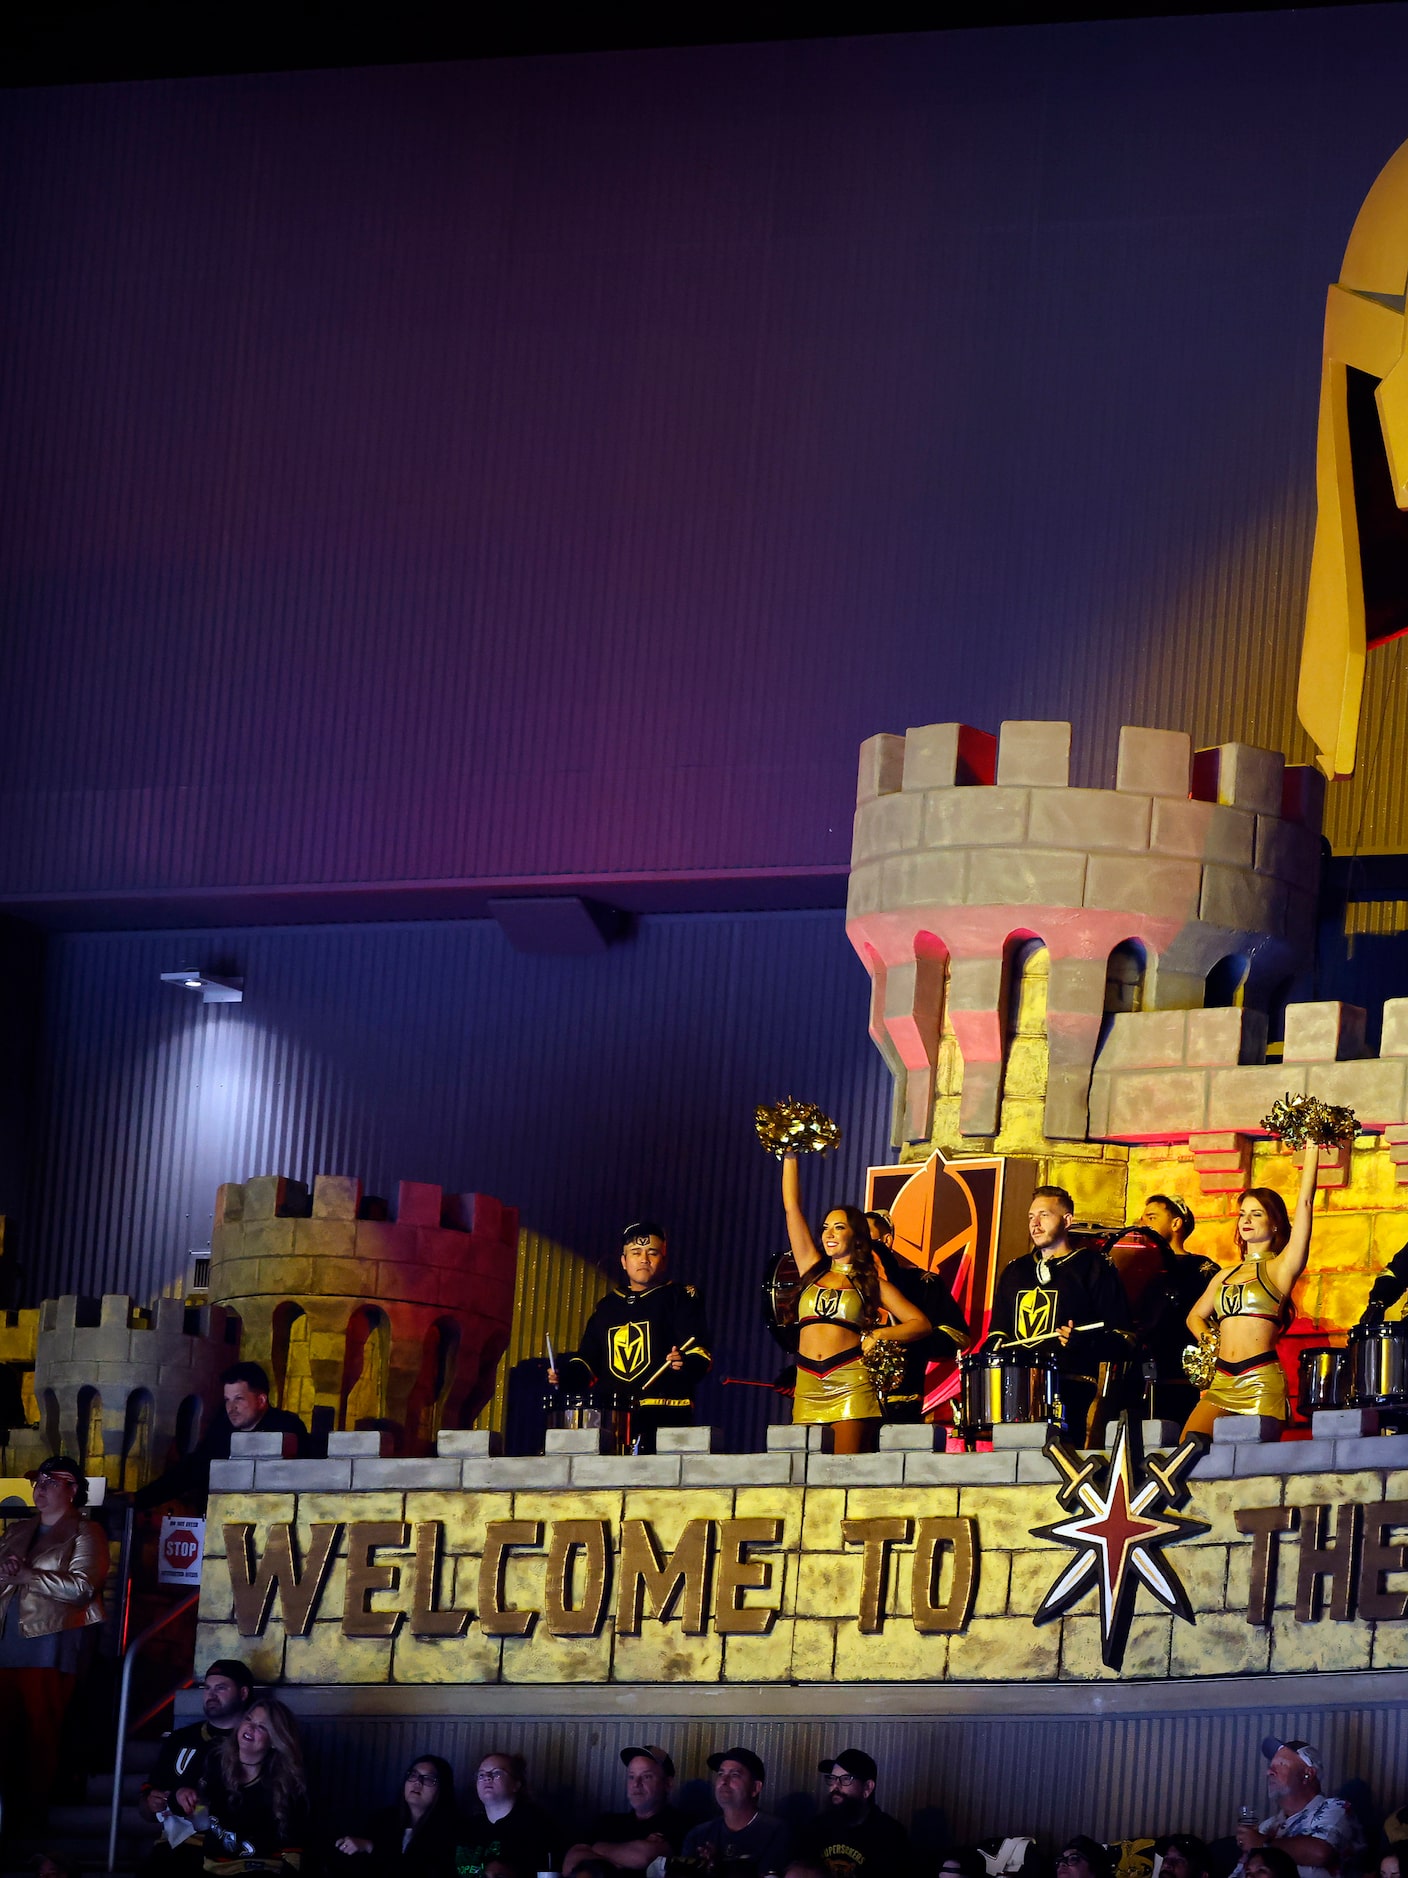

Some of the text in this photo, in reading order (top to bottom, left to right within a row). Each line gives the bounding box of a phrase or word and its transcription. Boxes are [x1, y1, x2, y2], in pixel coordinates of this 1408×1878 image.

[166, 1541, 197, 1557] STOP
[222, 1517, 784, 1637] WELCOME
[840, 1517, 981, 1635] TO
